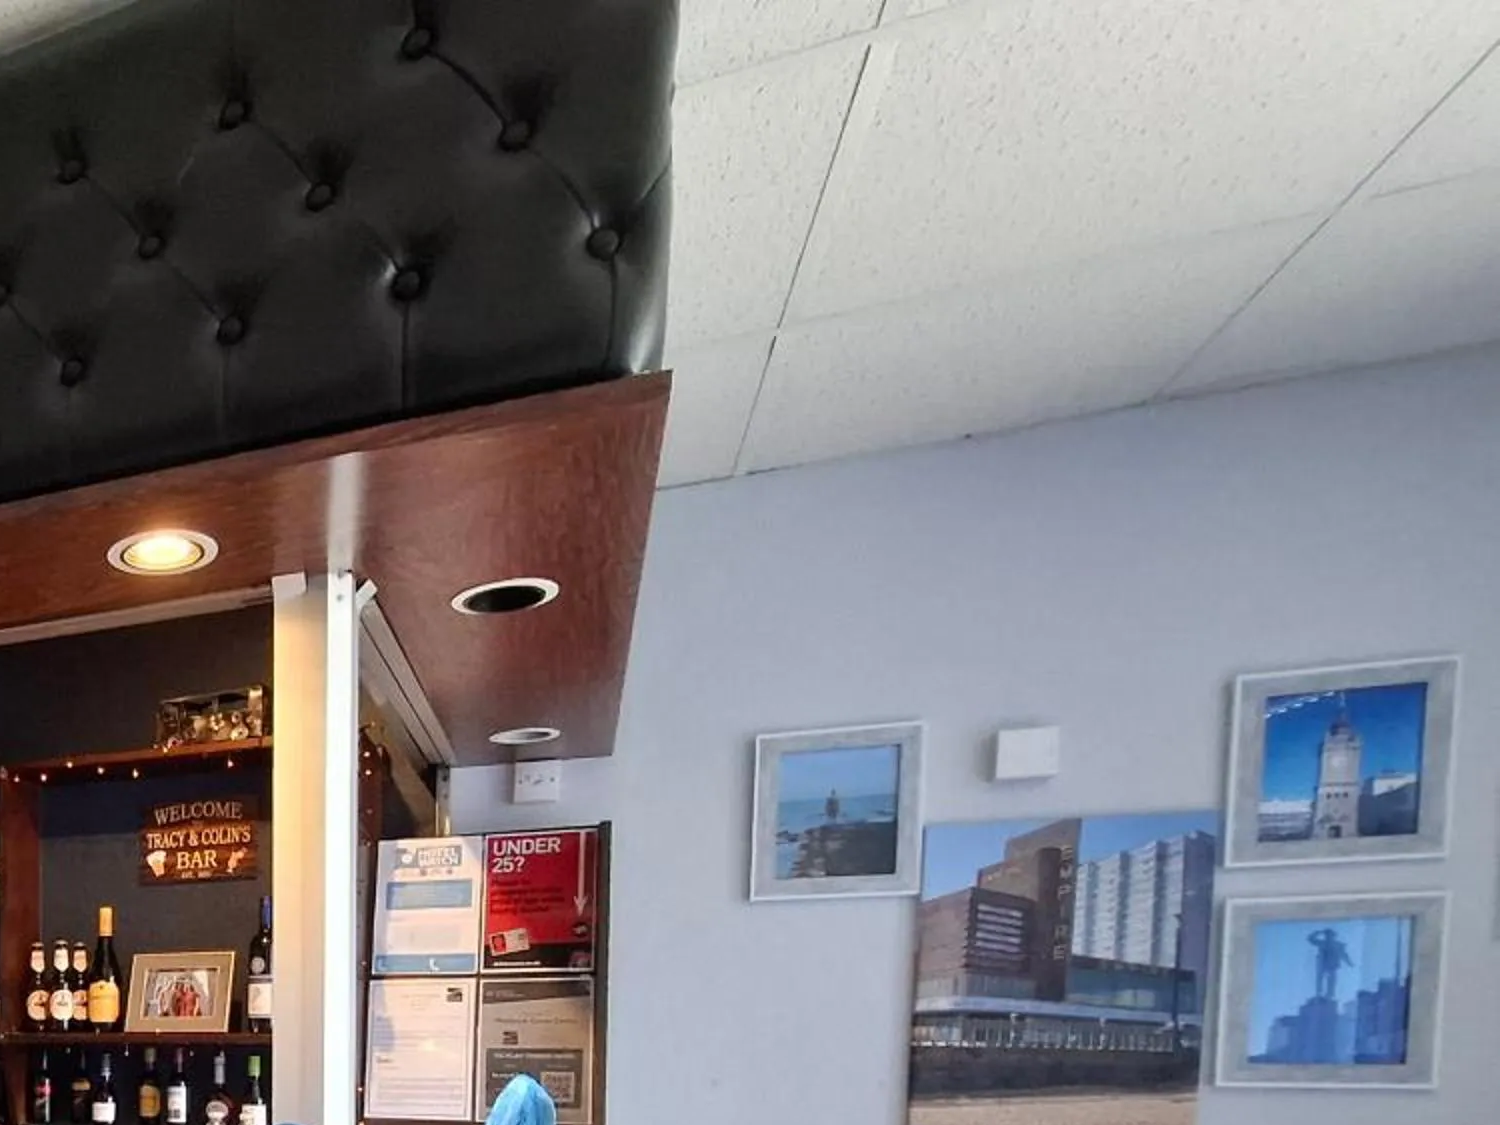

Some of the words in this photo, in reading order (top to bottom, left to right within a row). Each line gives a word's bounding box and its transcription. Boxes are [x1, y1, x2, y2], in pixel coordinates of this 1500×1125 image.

[154, 801, 243, 825] WELCOME
[146, 830, 186, 849] TRACY
[187, 829, 199, 847] &
[493, 837, 561, 856] UNDER
[176, 850, 217, 869] BAR
[491, 856, 525, 873] 25?
[1053, 846, 1075, 961] EMPIRE
